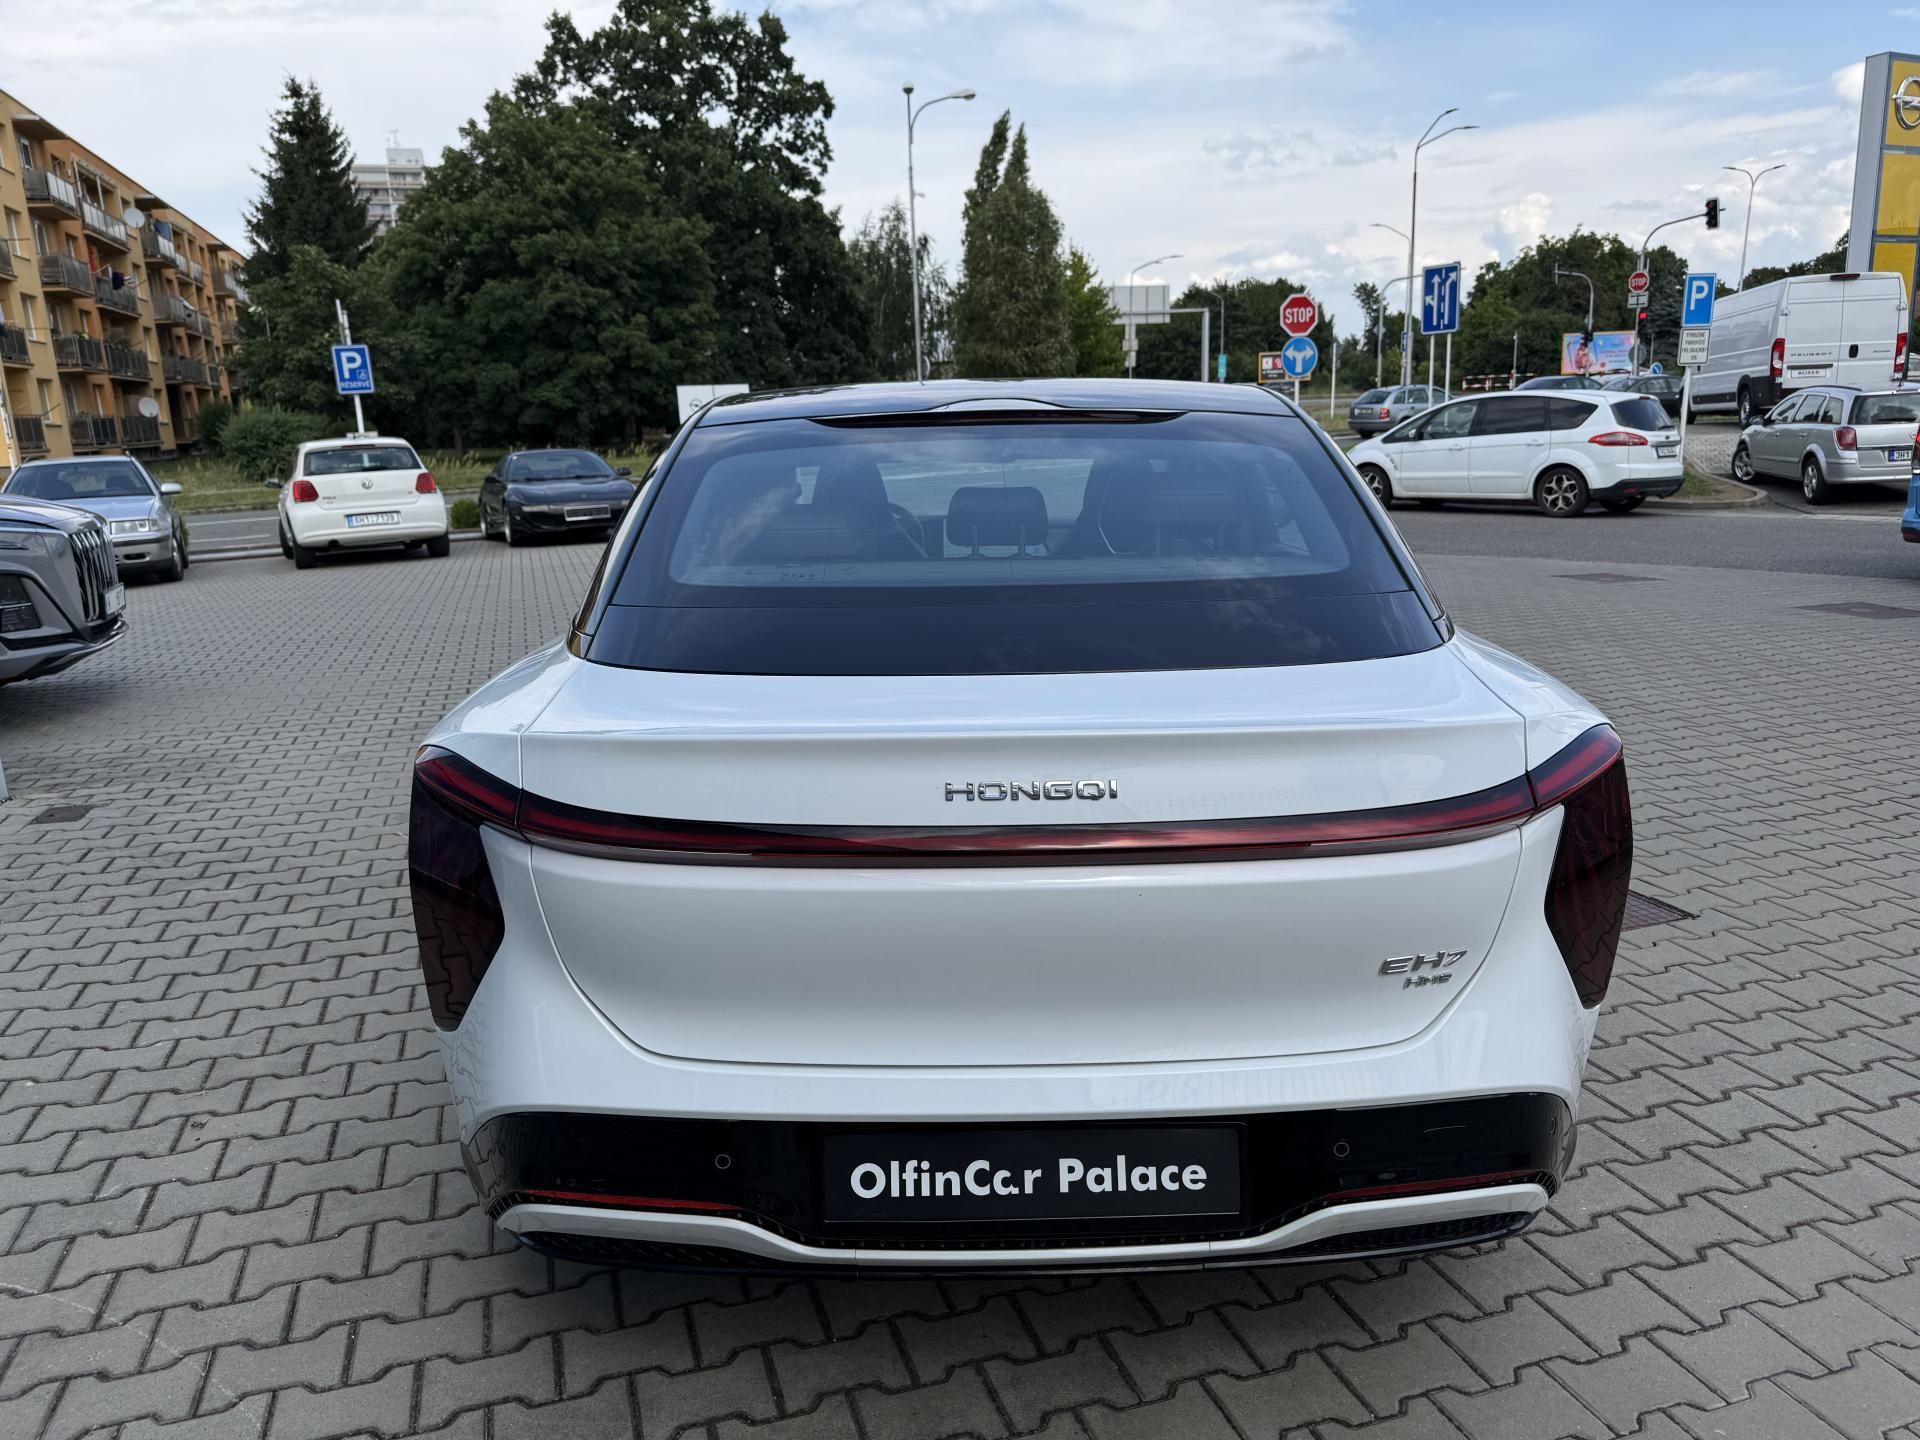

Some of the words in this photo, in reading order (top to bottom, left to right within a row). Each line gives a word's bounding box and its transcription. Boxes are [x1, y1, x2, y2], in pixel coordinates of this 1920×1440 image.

[1631, 277, 1647, 287] STOP
[1690, 280, 1709, 310] P
[1285, 307, 1313, 323] STOP
[340, 351, 362, 379] P
[945, 778, 1118, 801] HONGQI
[1378, 949, 1468, 976] EH7
[850, 1159, 1042, 1199] OlfinCar
[1058, 1154, 1208, 1193] Palace
